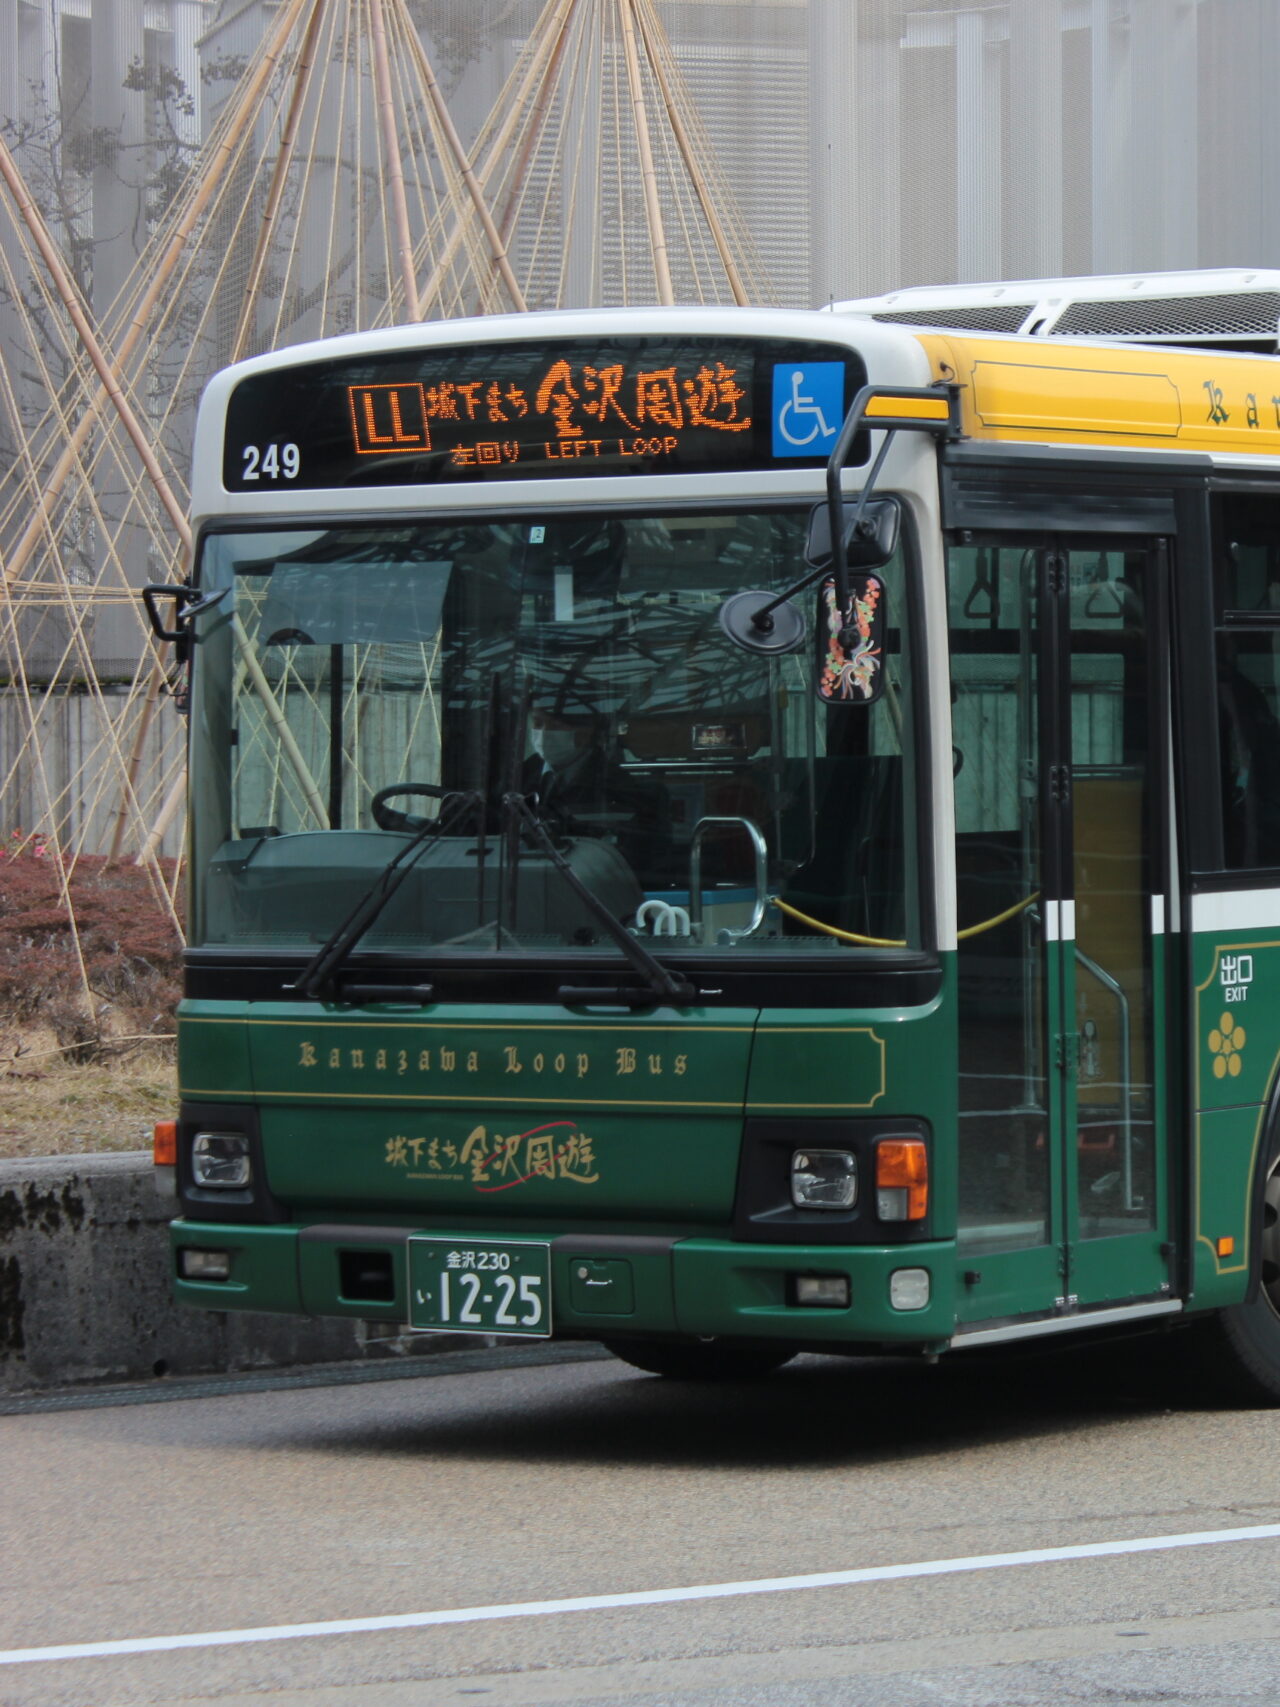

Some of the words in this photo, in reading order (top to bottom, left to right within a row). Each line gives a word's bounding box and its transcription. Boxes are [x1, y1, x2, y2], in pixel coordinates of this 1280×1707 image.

[364, 391, 420, 442] LL
[243, 443, 300, 480] 249
[450, 440, 519, 465] 左回り
[545, 440, 602, 460] LEFT
[619, 436, 678, 456] LOOP
[1221, 955, 1253, 985] 出口
[1225, 986, 1248, 1002] EXIT
[299, 1041, 479, 1075] Kanazawa
[504, 1046, 589, 1078] Loop
[616, 1047, 687, 1075] Bus
[416, 1289, 433, 1304] い
[441, 1272, 542, 1326] 12-25
